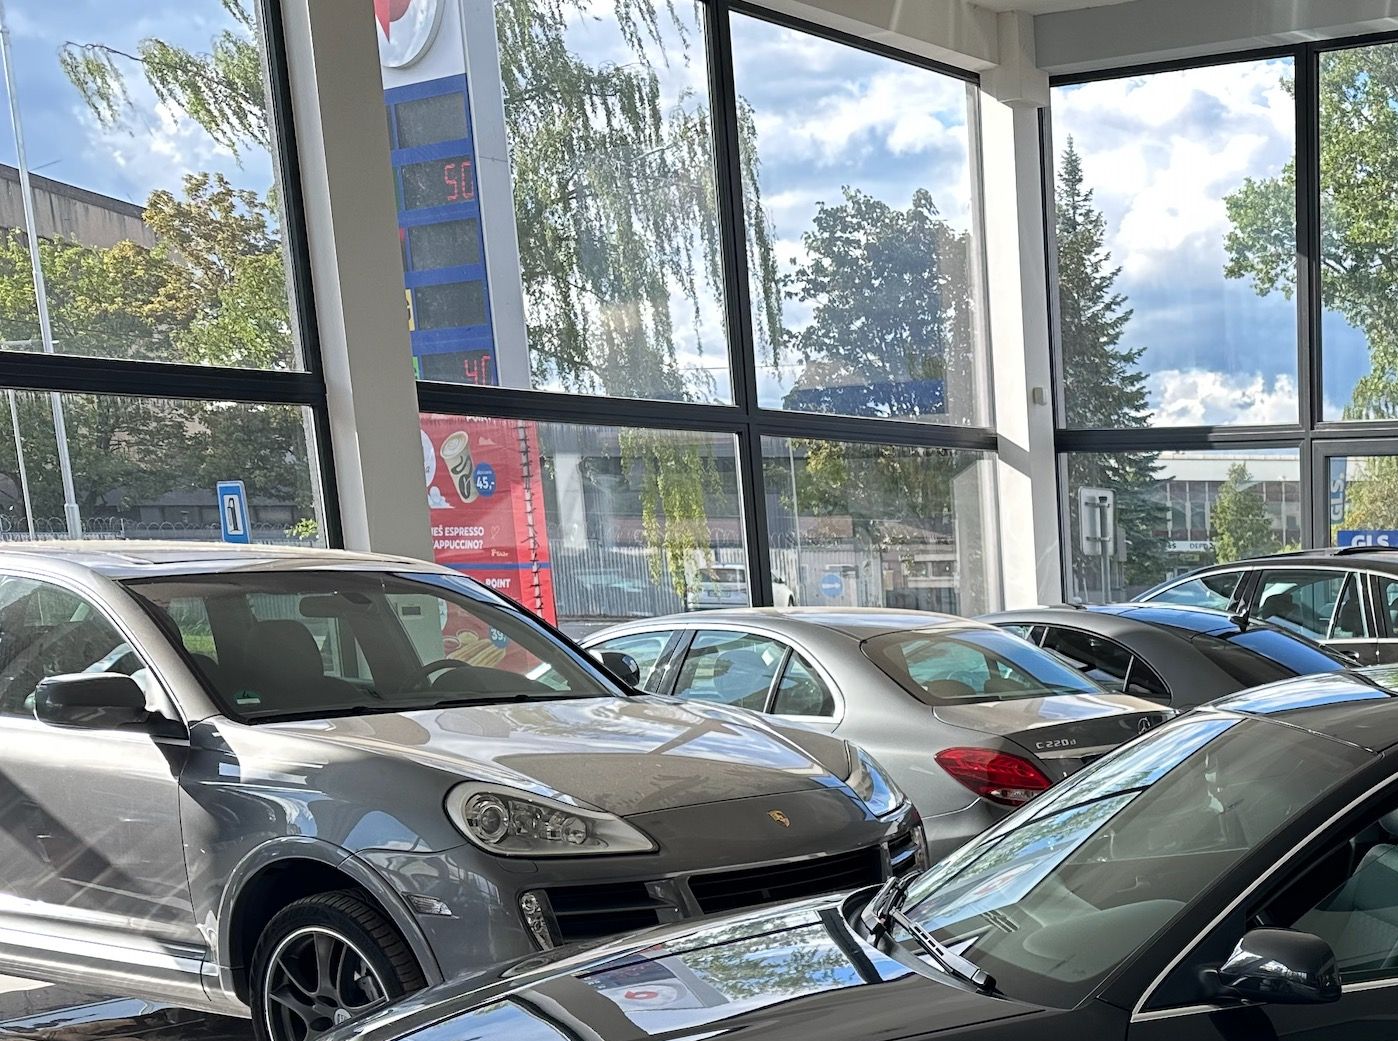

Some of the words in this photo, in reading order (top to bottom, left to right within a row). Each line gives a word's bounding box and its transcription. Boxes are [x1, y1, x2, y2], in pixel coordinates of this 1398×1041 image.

[476, 476, 495, 490] 45,-
[1330, 473, 1345, 521] GLS.
[445, 526, 484, 537] ESPRESSO
[432, 539, 483, 549] APPUCCINO?
